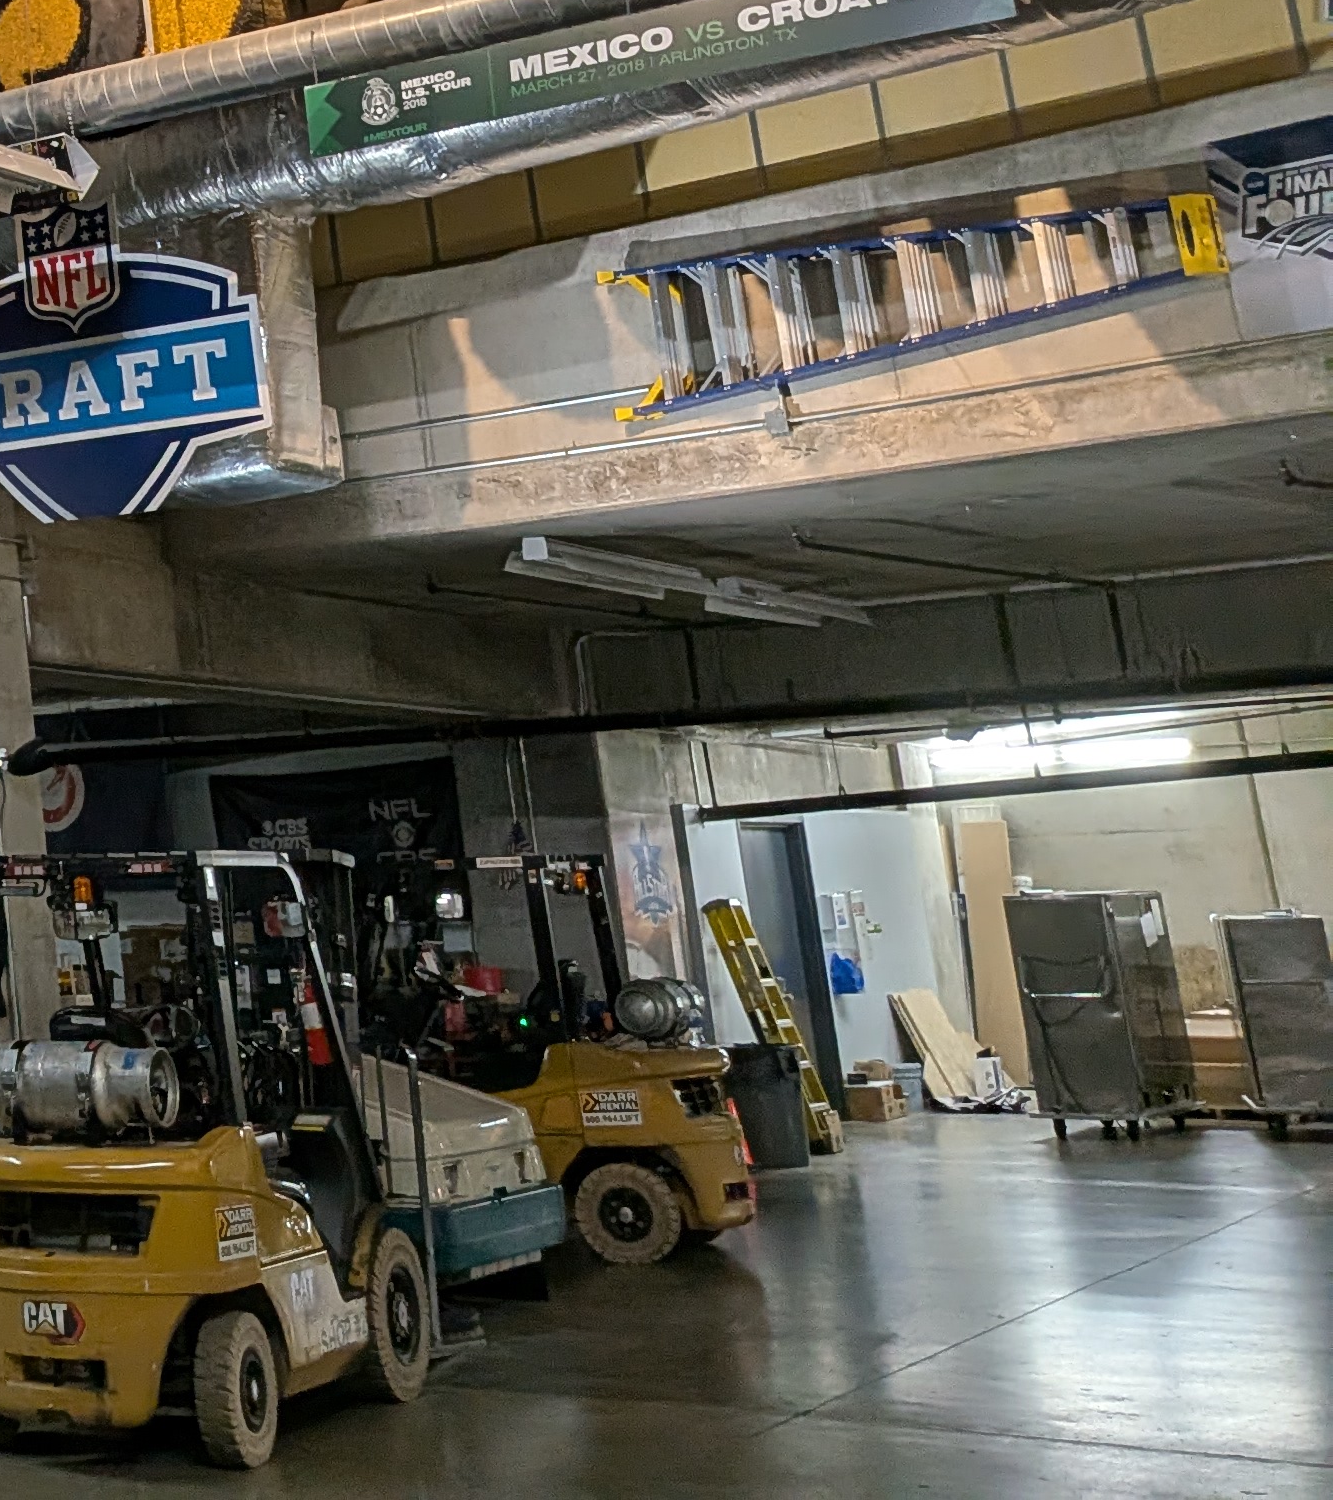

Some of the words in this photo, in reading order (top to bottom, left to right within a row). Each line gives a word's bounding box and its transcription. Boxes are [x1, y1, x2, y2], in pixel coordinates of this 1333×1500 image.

[509, 26, 674, 82] MEXICO
[685, 19, 725, 44] VS
[511, 73, 575, 100] MARCH
[606, 58, 645, 79] 2018
[773, 26, 799, 43] TX
[400, 70, 456, 90] MEXICO
[401, 87, 430, 100] U.S.
[433, 76, 472, 94] TOUR
[403, 97, 427, 110] 2018
[33, 250, 107, 310] NFL
[368, 798, 431, 821] NFL
[599, 1092, 637, 1102] DARR
[599, 1101, 639, 1111] RENTAL
[23, 1301, 68, 1336] CAT
